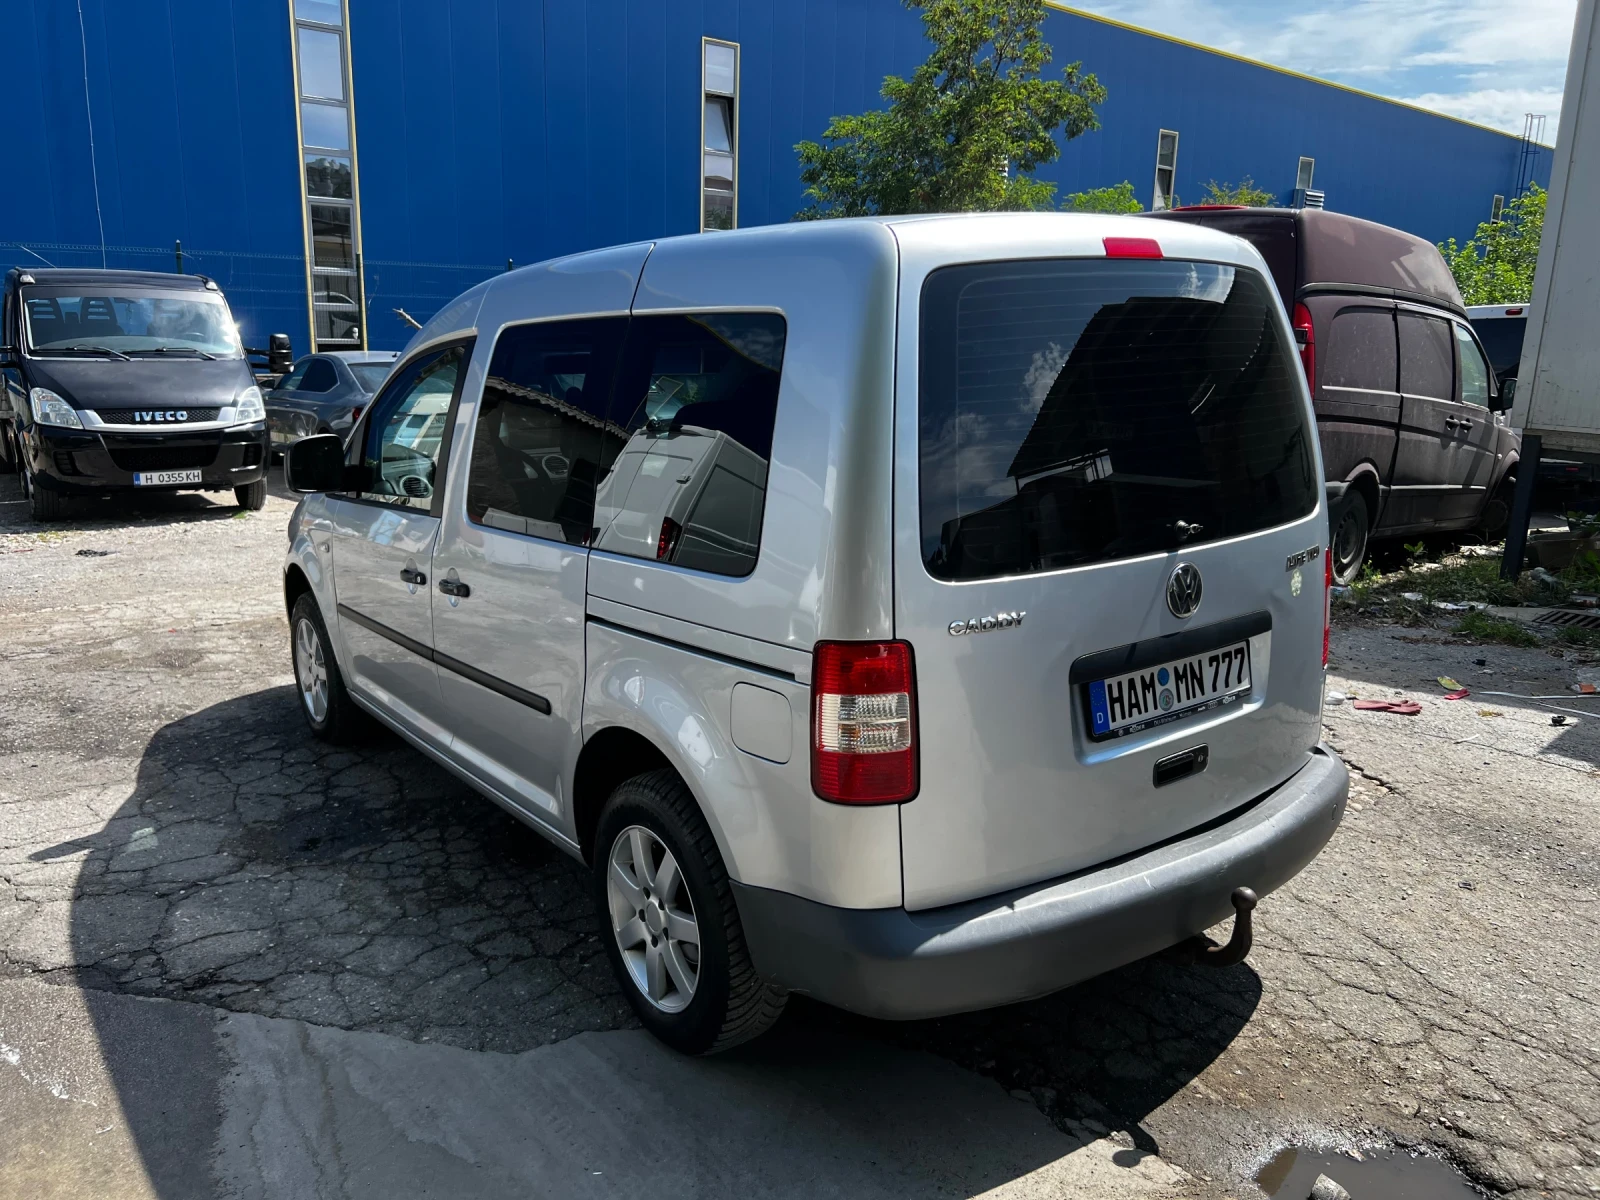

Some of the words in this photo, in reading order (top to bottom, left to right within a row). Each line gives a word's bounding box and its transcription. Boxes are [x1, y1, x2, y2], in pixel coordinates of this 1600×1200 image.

[134, 411, 188, 422] IVECO
[145, 474, 153, 484] H
[158, 472, 185, 483] 0355
[186, 471, 200, 481] KH
[948, 611, 1027, 636] CADDY
[1107, 672, 1159, 723] HAM
[1173, 659, 1206, 704] MN
[1208, 647, 1246, 693] 777
